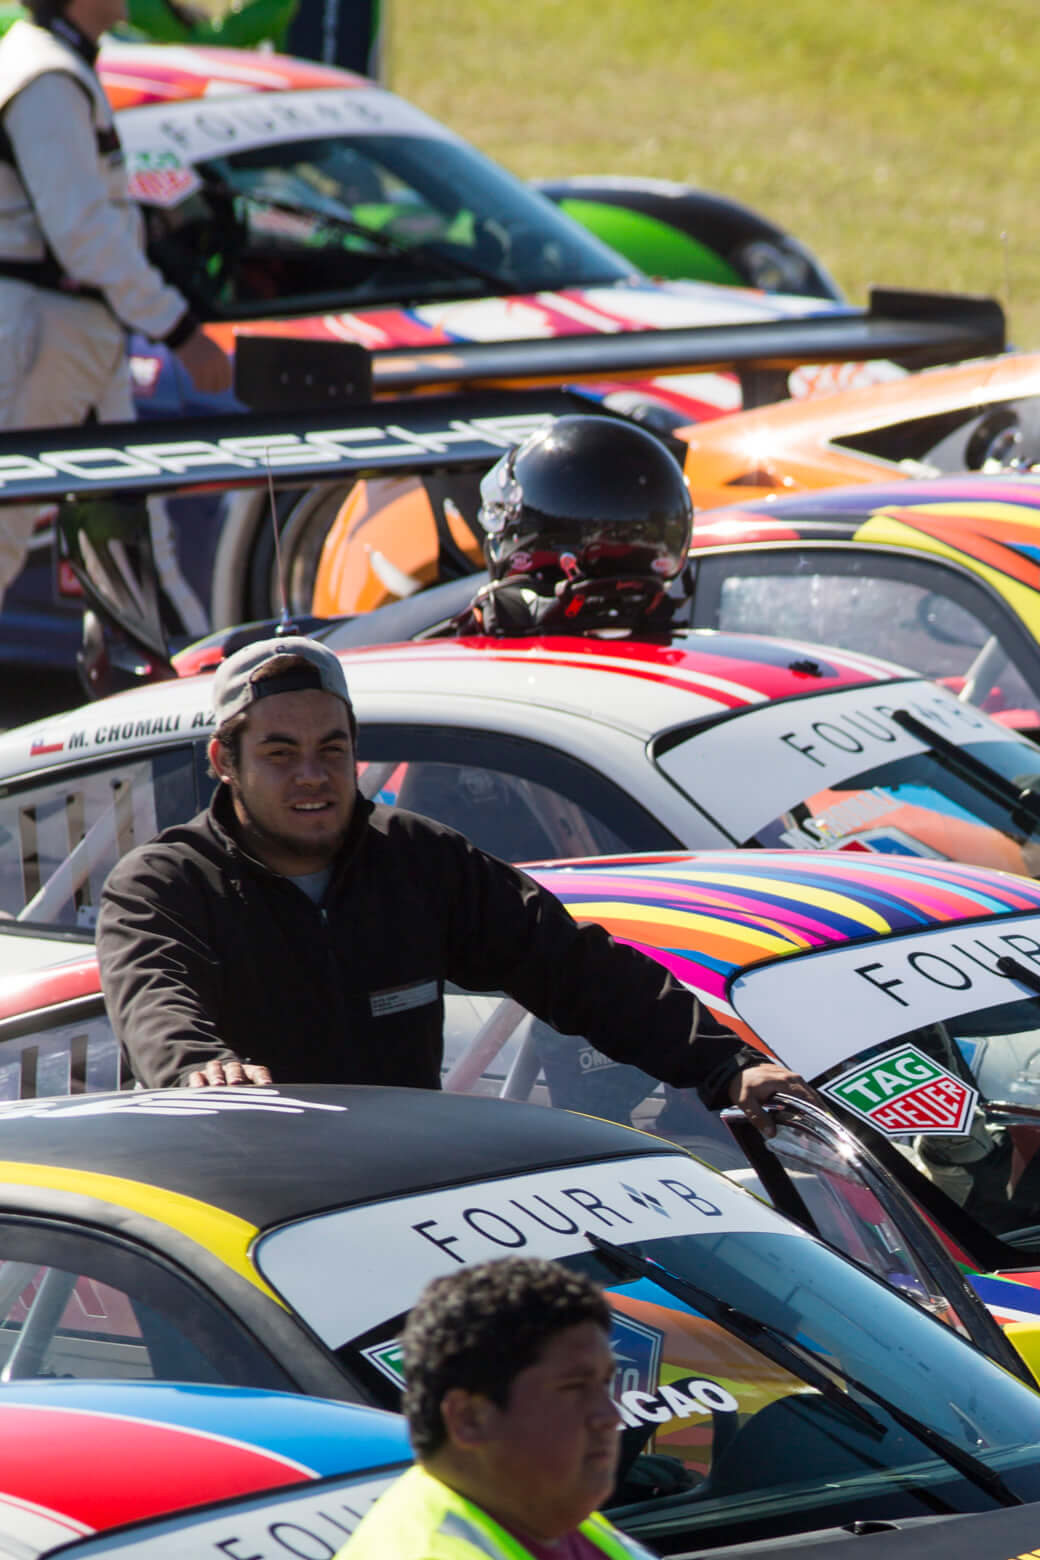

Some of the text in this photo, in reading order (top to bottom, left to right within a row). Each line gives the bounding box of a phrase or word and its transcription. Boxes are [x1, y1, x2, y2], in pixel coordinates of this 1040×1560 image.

[68, 730, 88, 750] M.
[95, 714, 181, 744] CHOMALI
[579, 1050, 613, 1069] OM
[842, 1057, 934, 1103] TAG
[875, 1080, 963, 1126] HEUER
[411, 1179, 723, 1263] FOUR B
